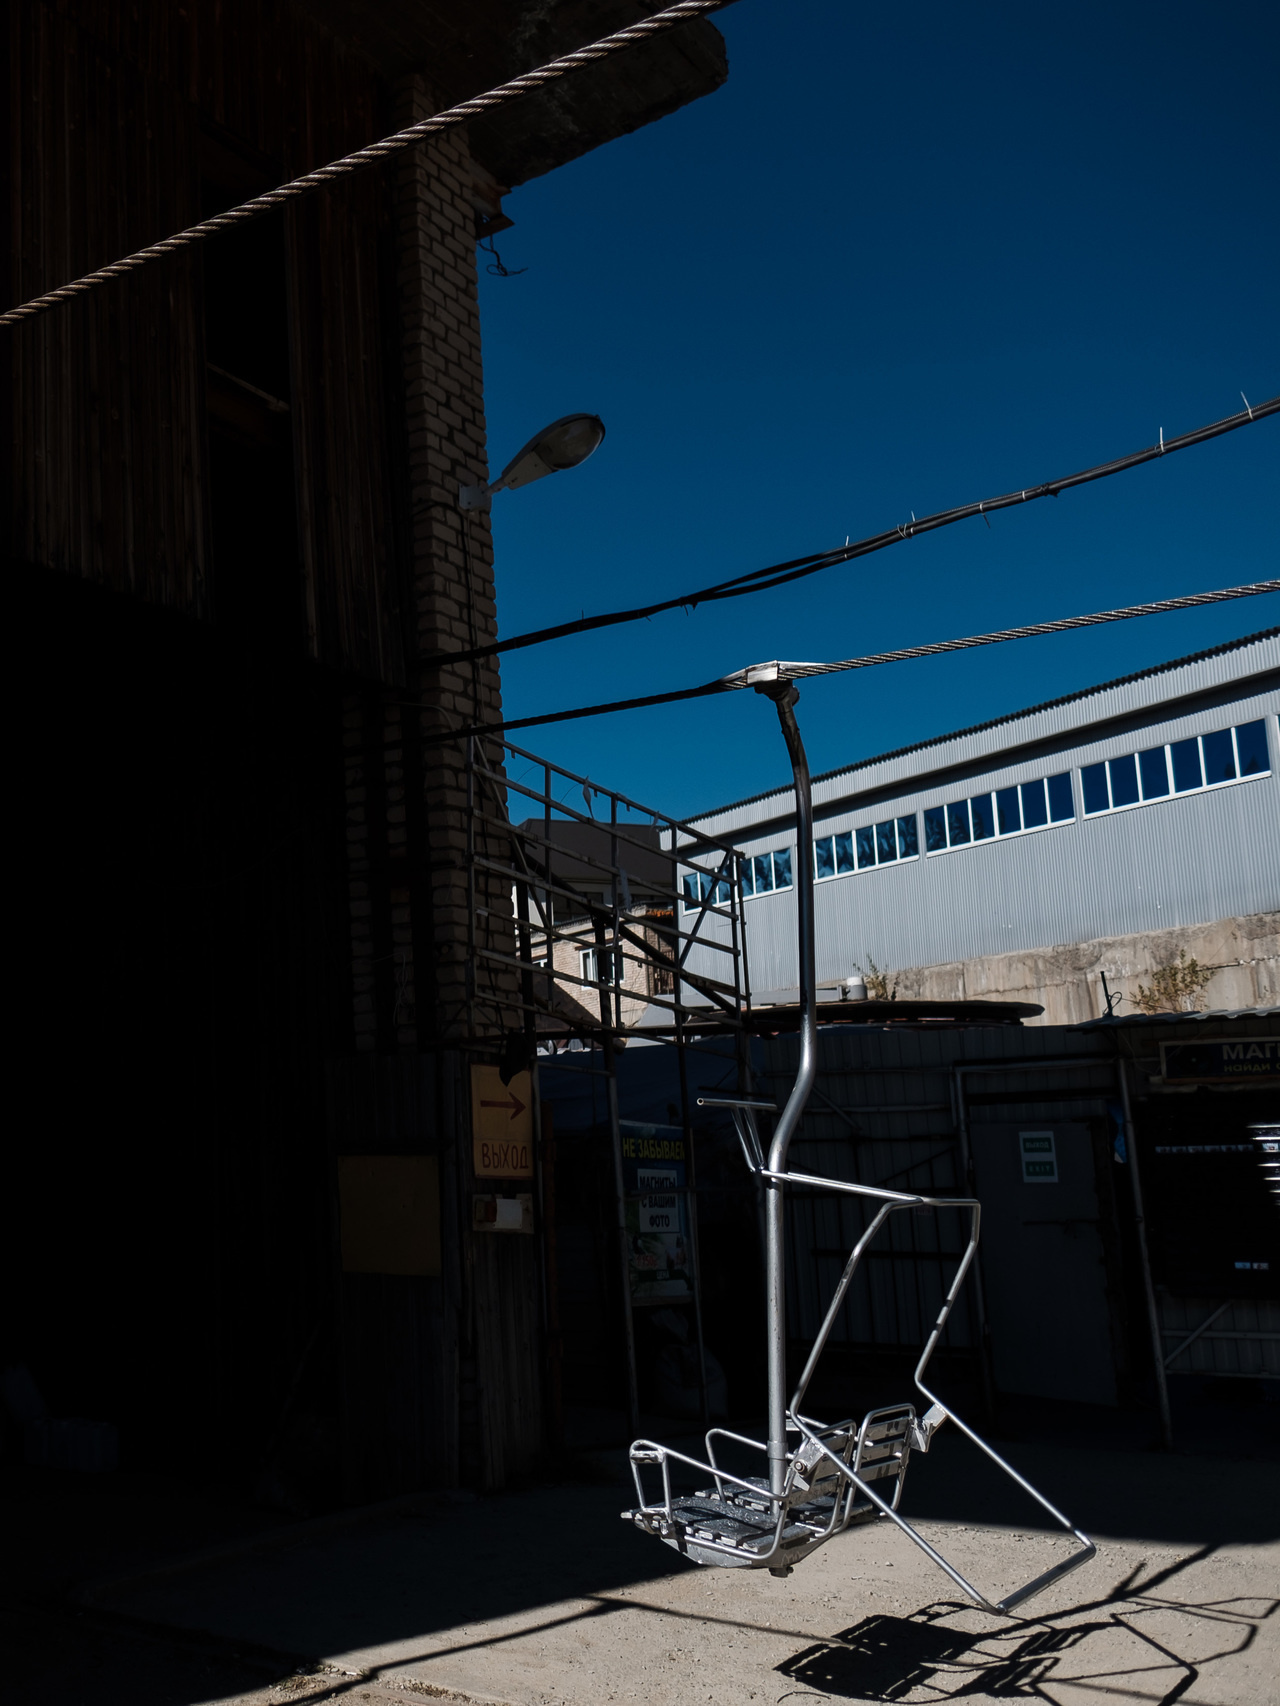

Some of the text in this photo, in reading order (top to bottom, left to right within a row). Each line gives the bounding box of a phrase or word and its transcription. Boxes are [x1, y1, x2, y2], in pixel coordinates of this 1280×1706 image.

[623, 1137, 636, 1158] НЕ
[481, 1142, 529, 1170] ВЫХОД
[639, 1176, 676, 1190] МАГНИТЫ
[648, 1195, 676, 1209] ВАШИМ
[649, 1214, 670, 1228] ФОТО
